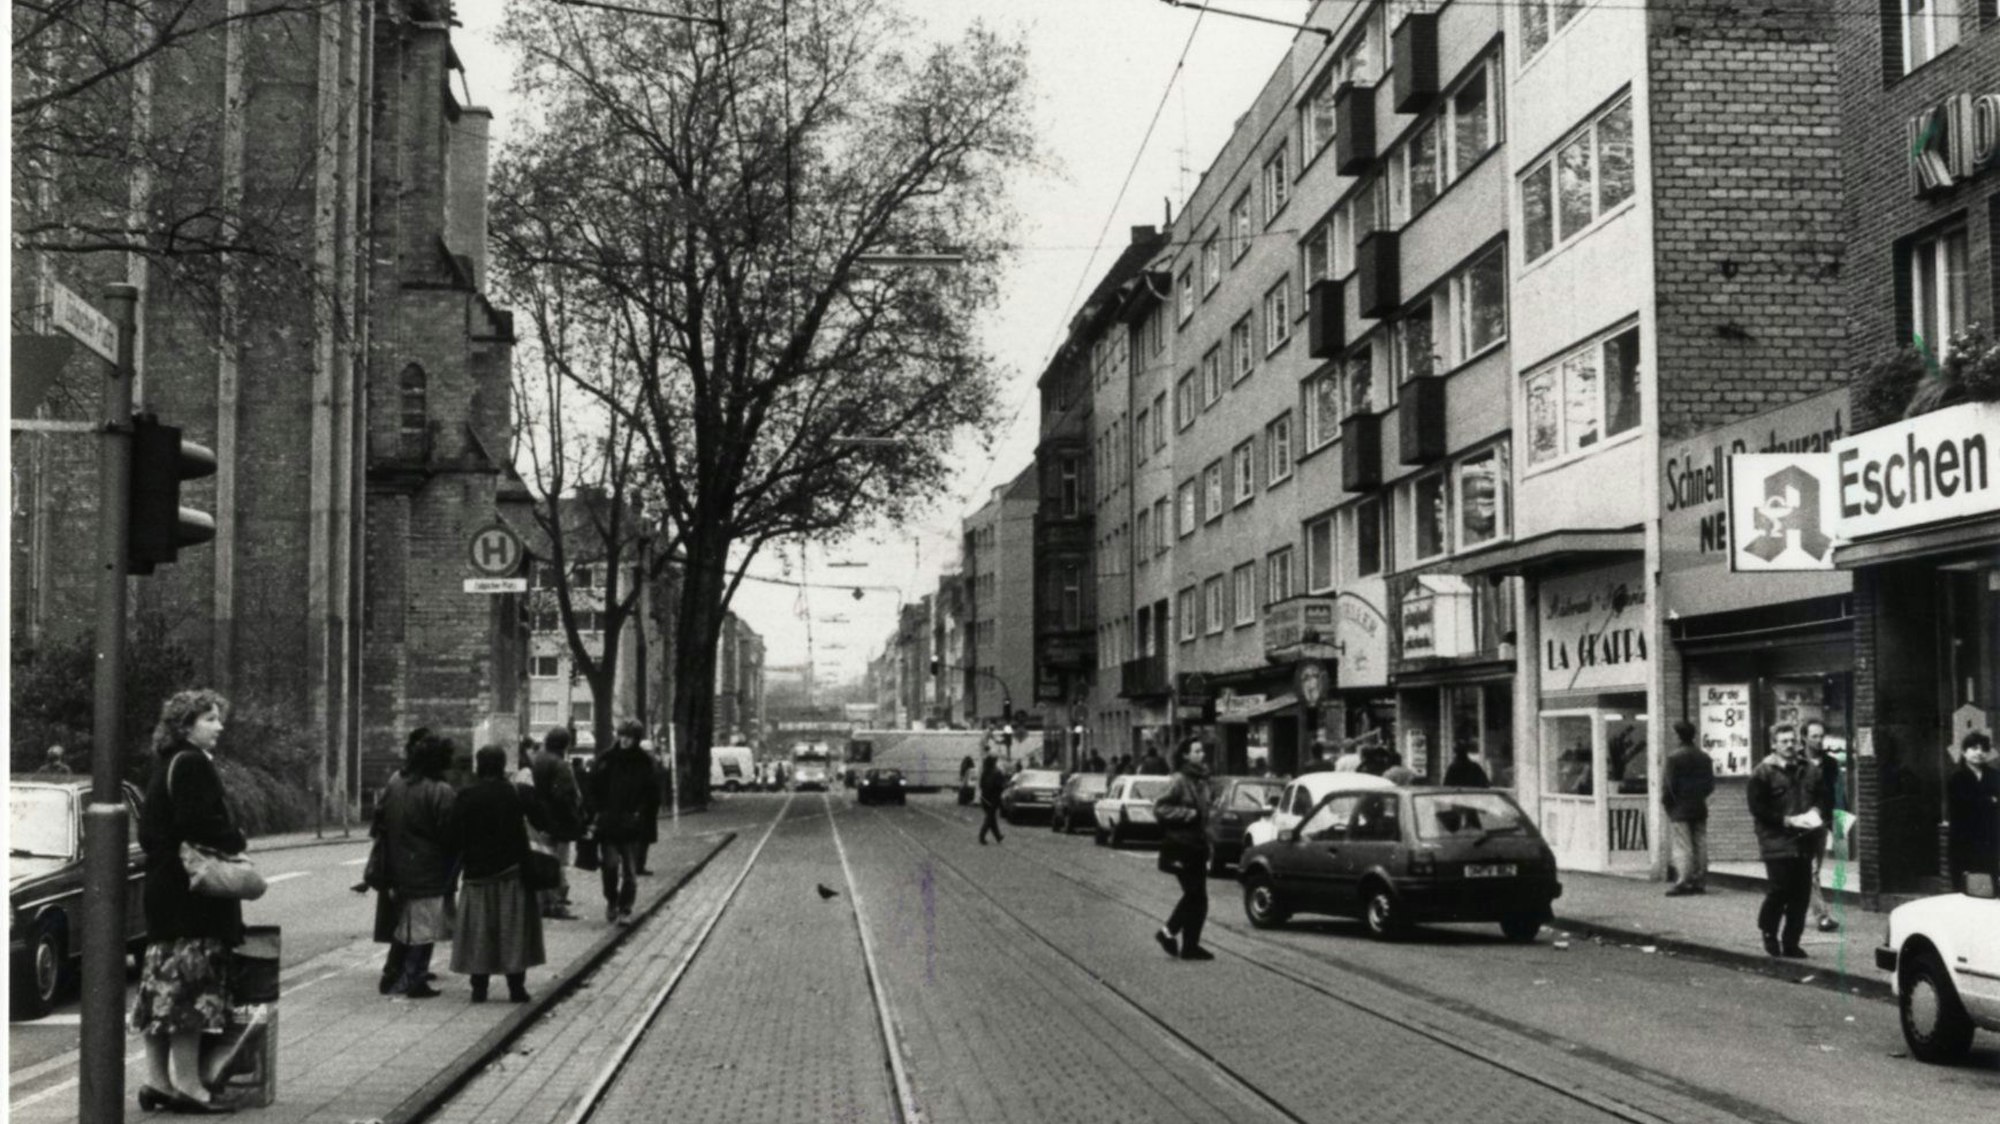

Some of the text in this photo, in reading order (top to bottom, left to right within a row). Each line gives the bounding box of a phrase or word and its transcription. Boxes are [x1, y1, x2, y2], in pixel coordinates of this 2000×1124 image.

[1666, 445, 1724, 512] Schnell
[1838, 431, 1988, 519] Eschen
[481, 536, 508, 566] H
[1547, 627, 1648, 671] LA GRAPPA
[1608, 808, 1649, 852] PIZZA
